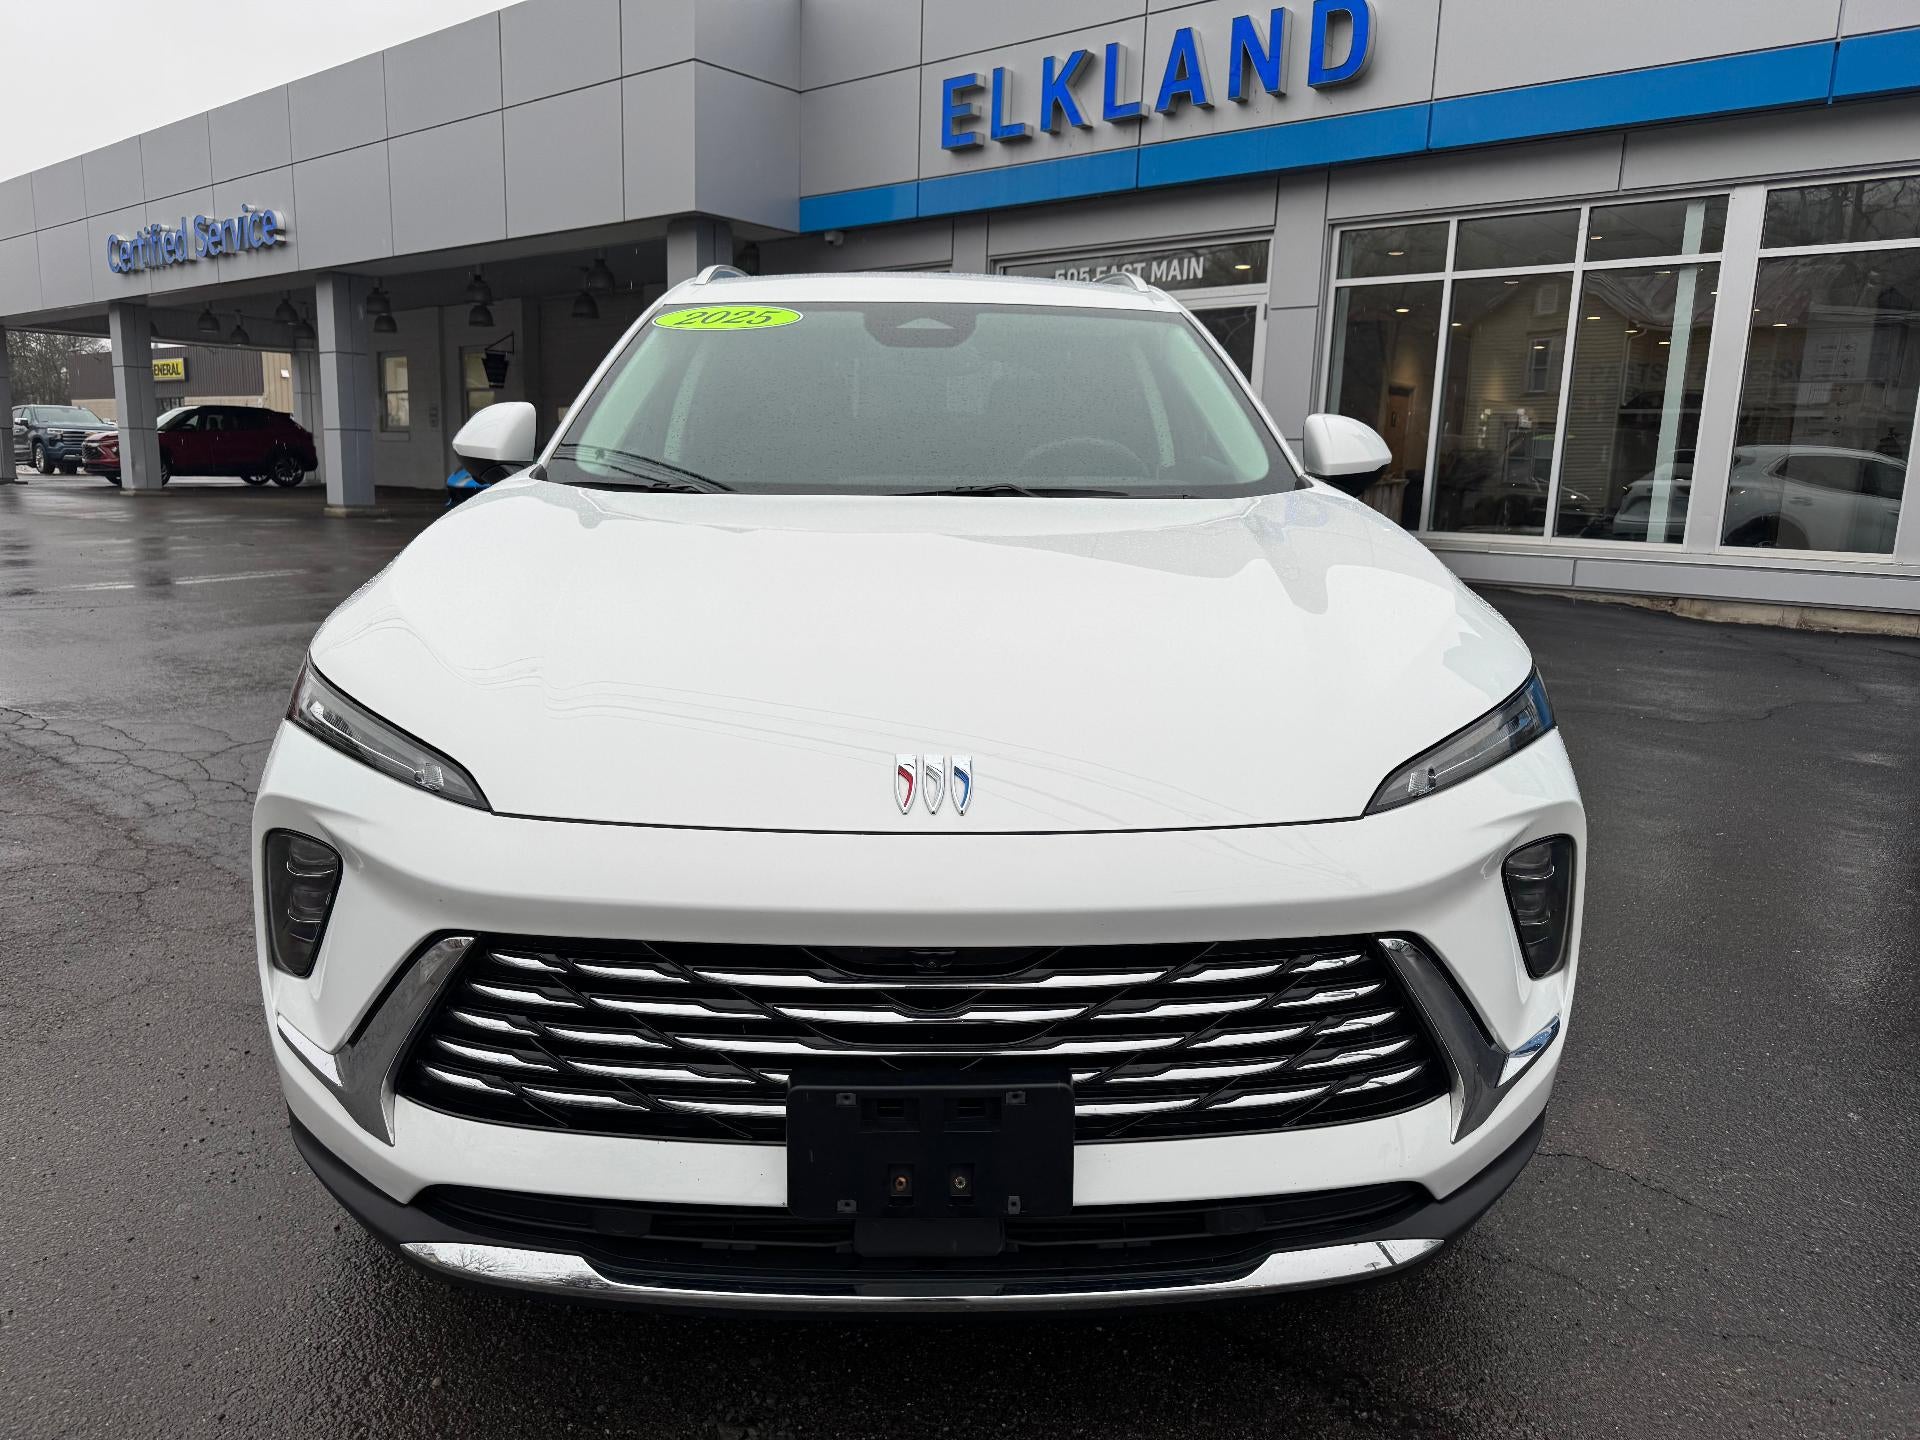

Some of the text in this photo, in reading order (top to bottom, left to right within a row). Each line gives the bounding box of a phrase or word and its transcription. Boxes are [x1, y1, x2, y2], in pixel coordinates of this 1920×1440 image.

[941, 0, 1372, 151] ELKLAND
[107, 203, 279, 273] Certified Service
[1150, 257, 1204, 282] MAIN
[674, 310, 782, 326] 2025
[153, 362, 181, 376] ENERAL
